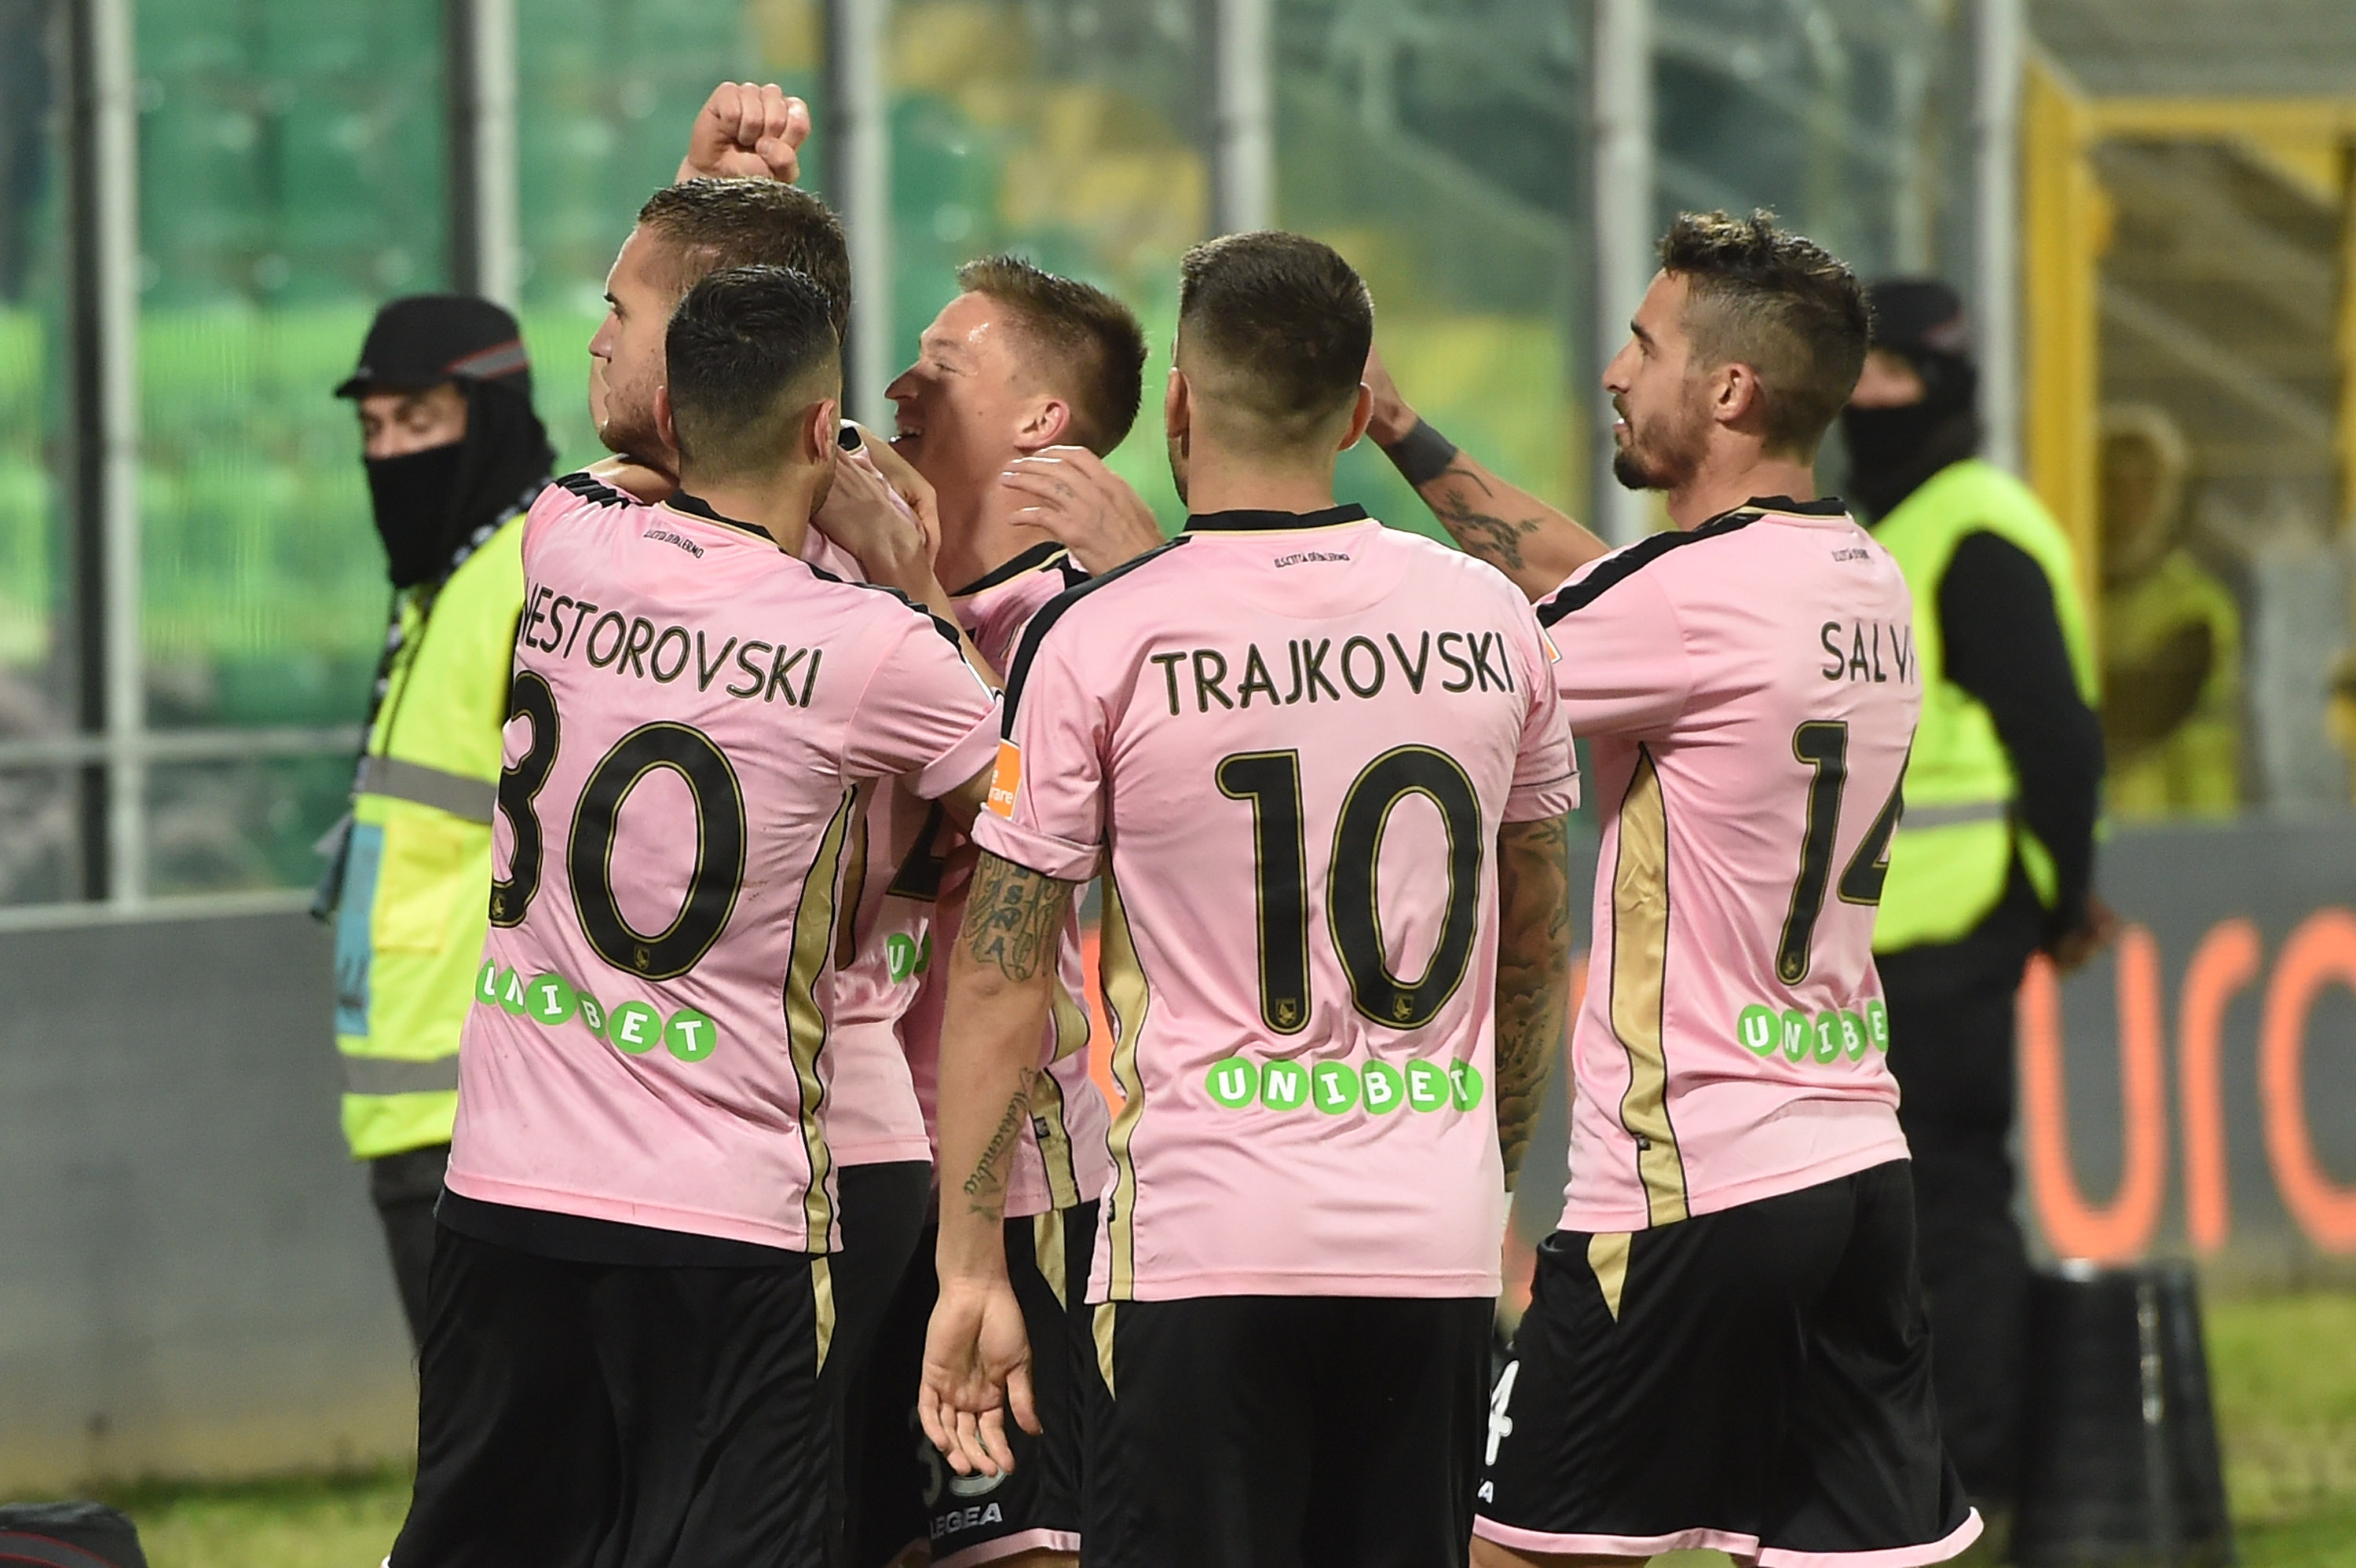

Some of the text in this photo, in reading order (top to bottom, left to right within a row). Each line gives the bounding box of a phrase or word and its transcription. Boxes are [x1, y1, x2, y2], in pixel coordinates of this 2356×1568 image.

[1151, 630, 1515, 715] TRAJKOVSKI
[488, 670, 748, 982] 30
[1215, 744, 1483, 1033] 10
[1214, 1064, 1471, 1106] UNIBET
